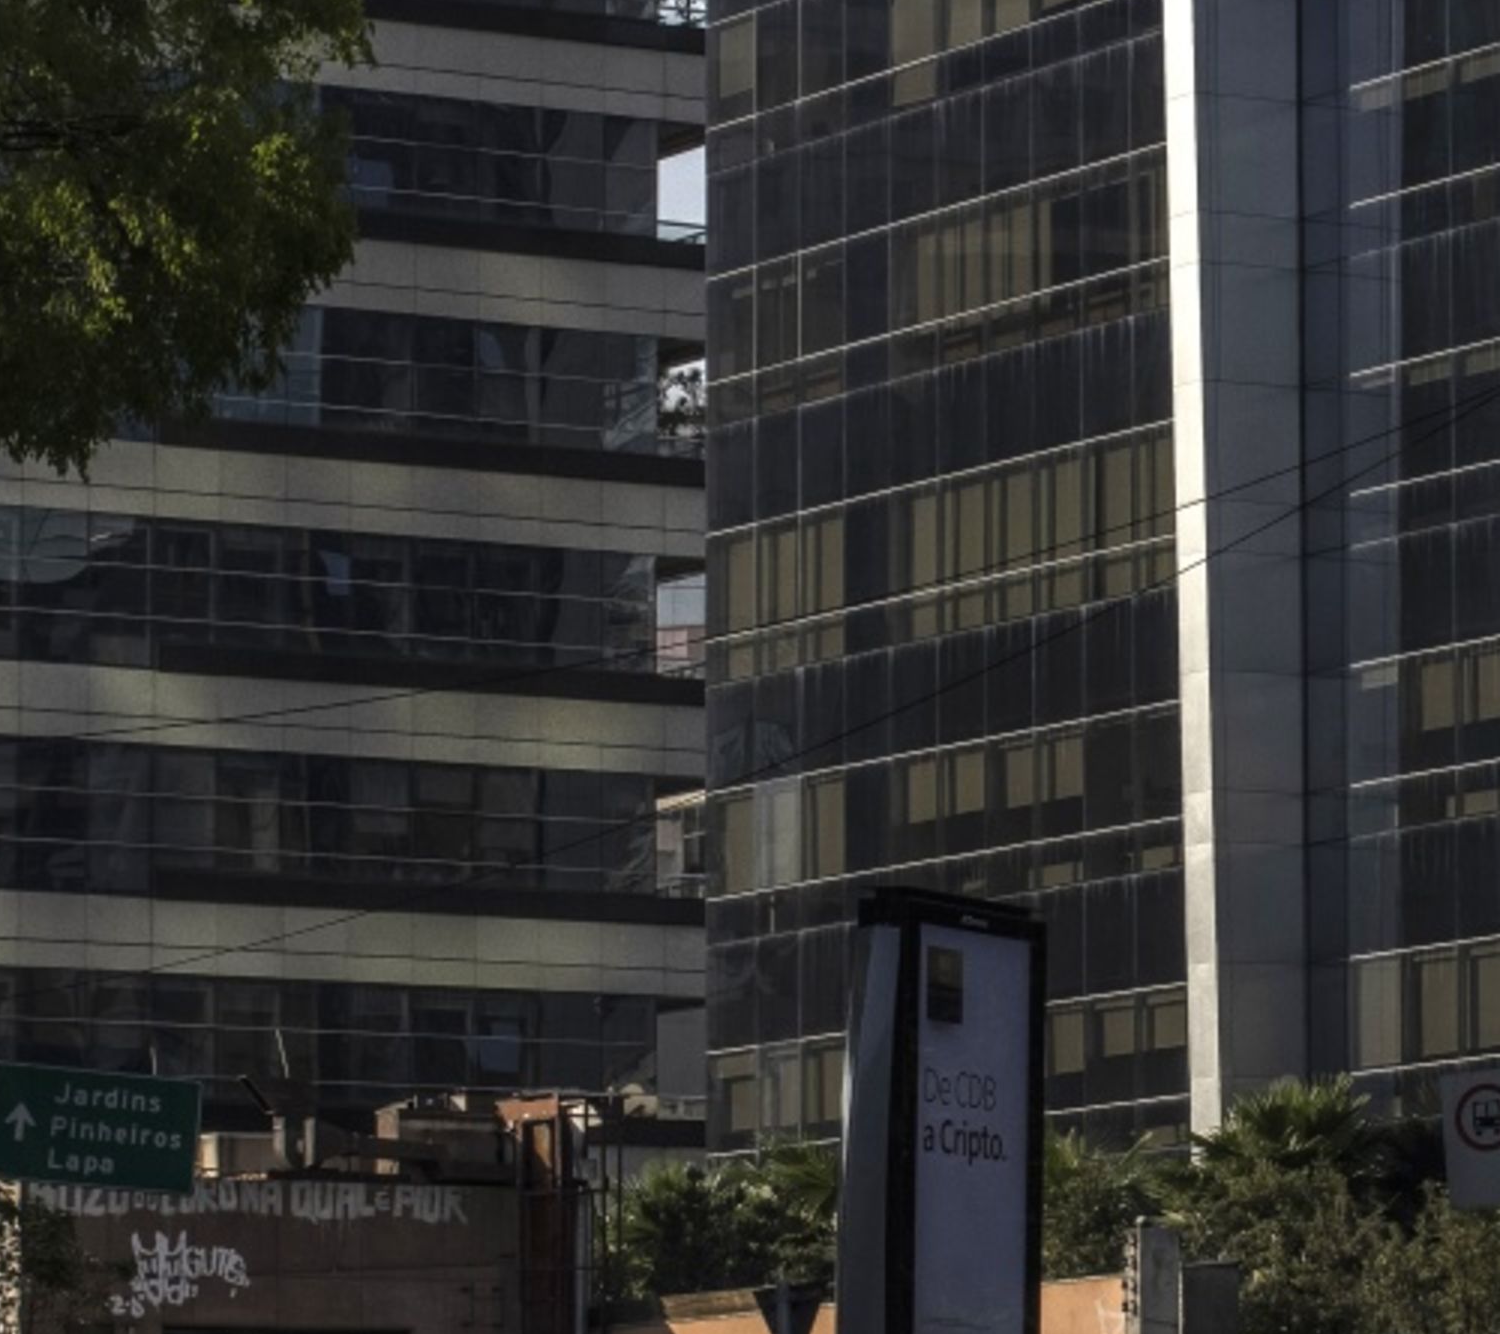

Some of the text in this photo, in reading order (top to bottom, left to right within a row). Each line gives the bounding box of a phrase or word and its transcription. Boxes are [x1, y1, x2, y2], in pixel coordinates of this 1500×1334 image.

[53, 1081, 163, 1114] Jardins
[923, 1067, 997, 1112] De CDB
[50, 1115, 183, 1150] Pinheiros
[923, 1119, 1008, 1166] a Cripto.
[47, 1147, 116, 1176] Lapa
[290, 1179, 377, 1225] QUAL
[393, 1183, 469, 1225] PIOR
